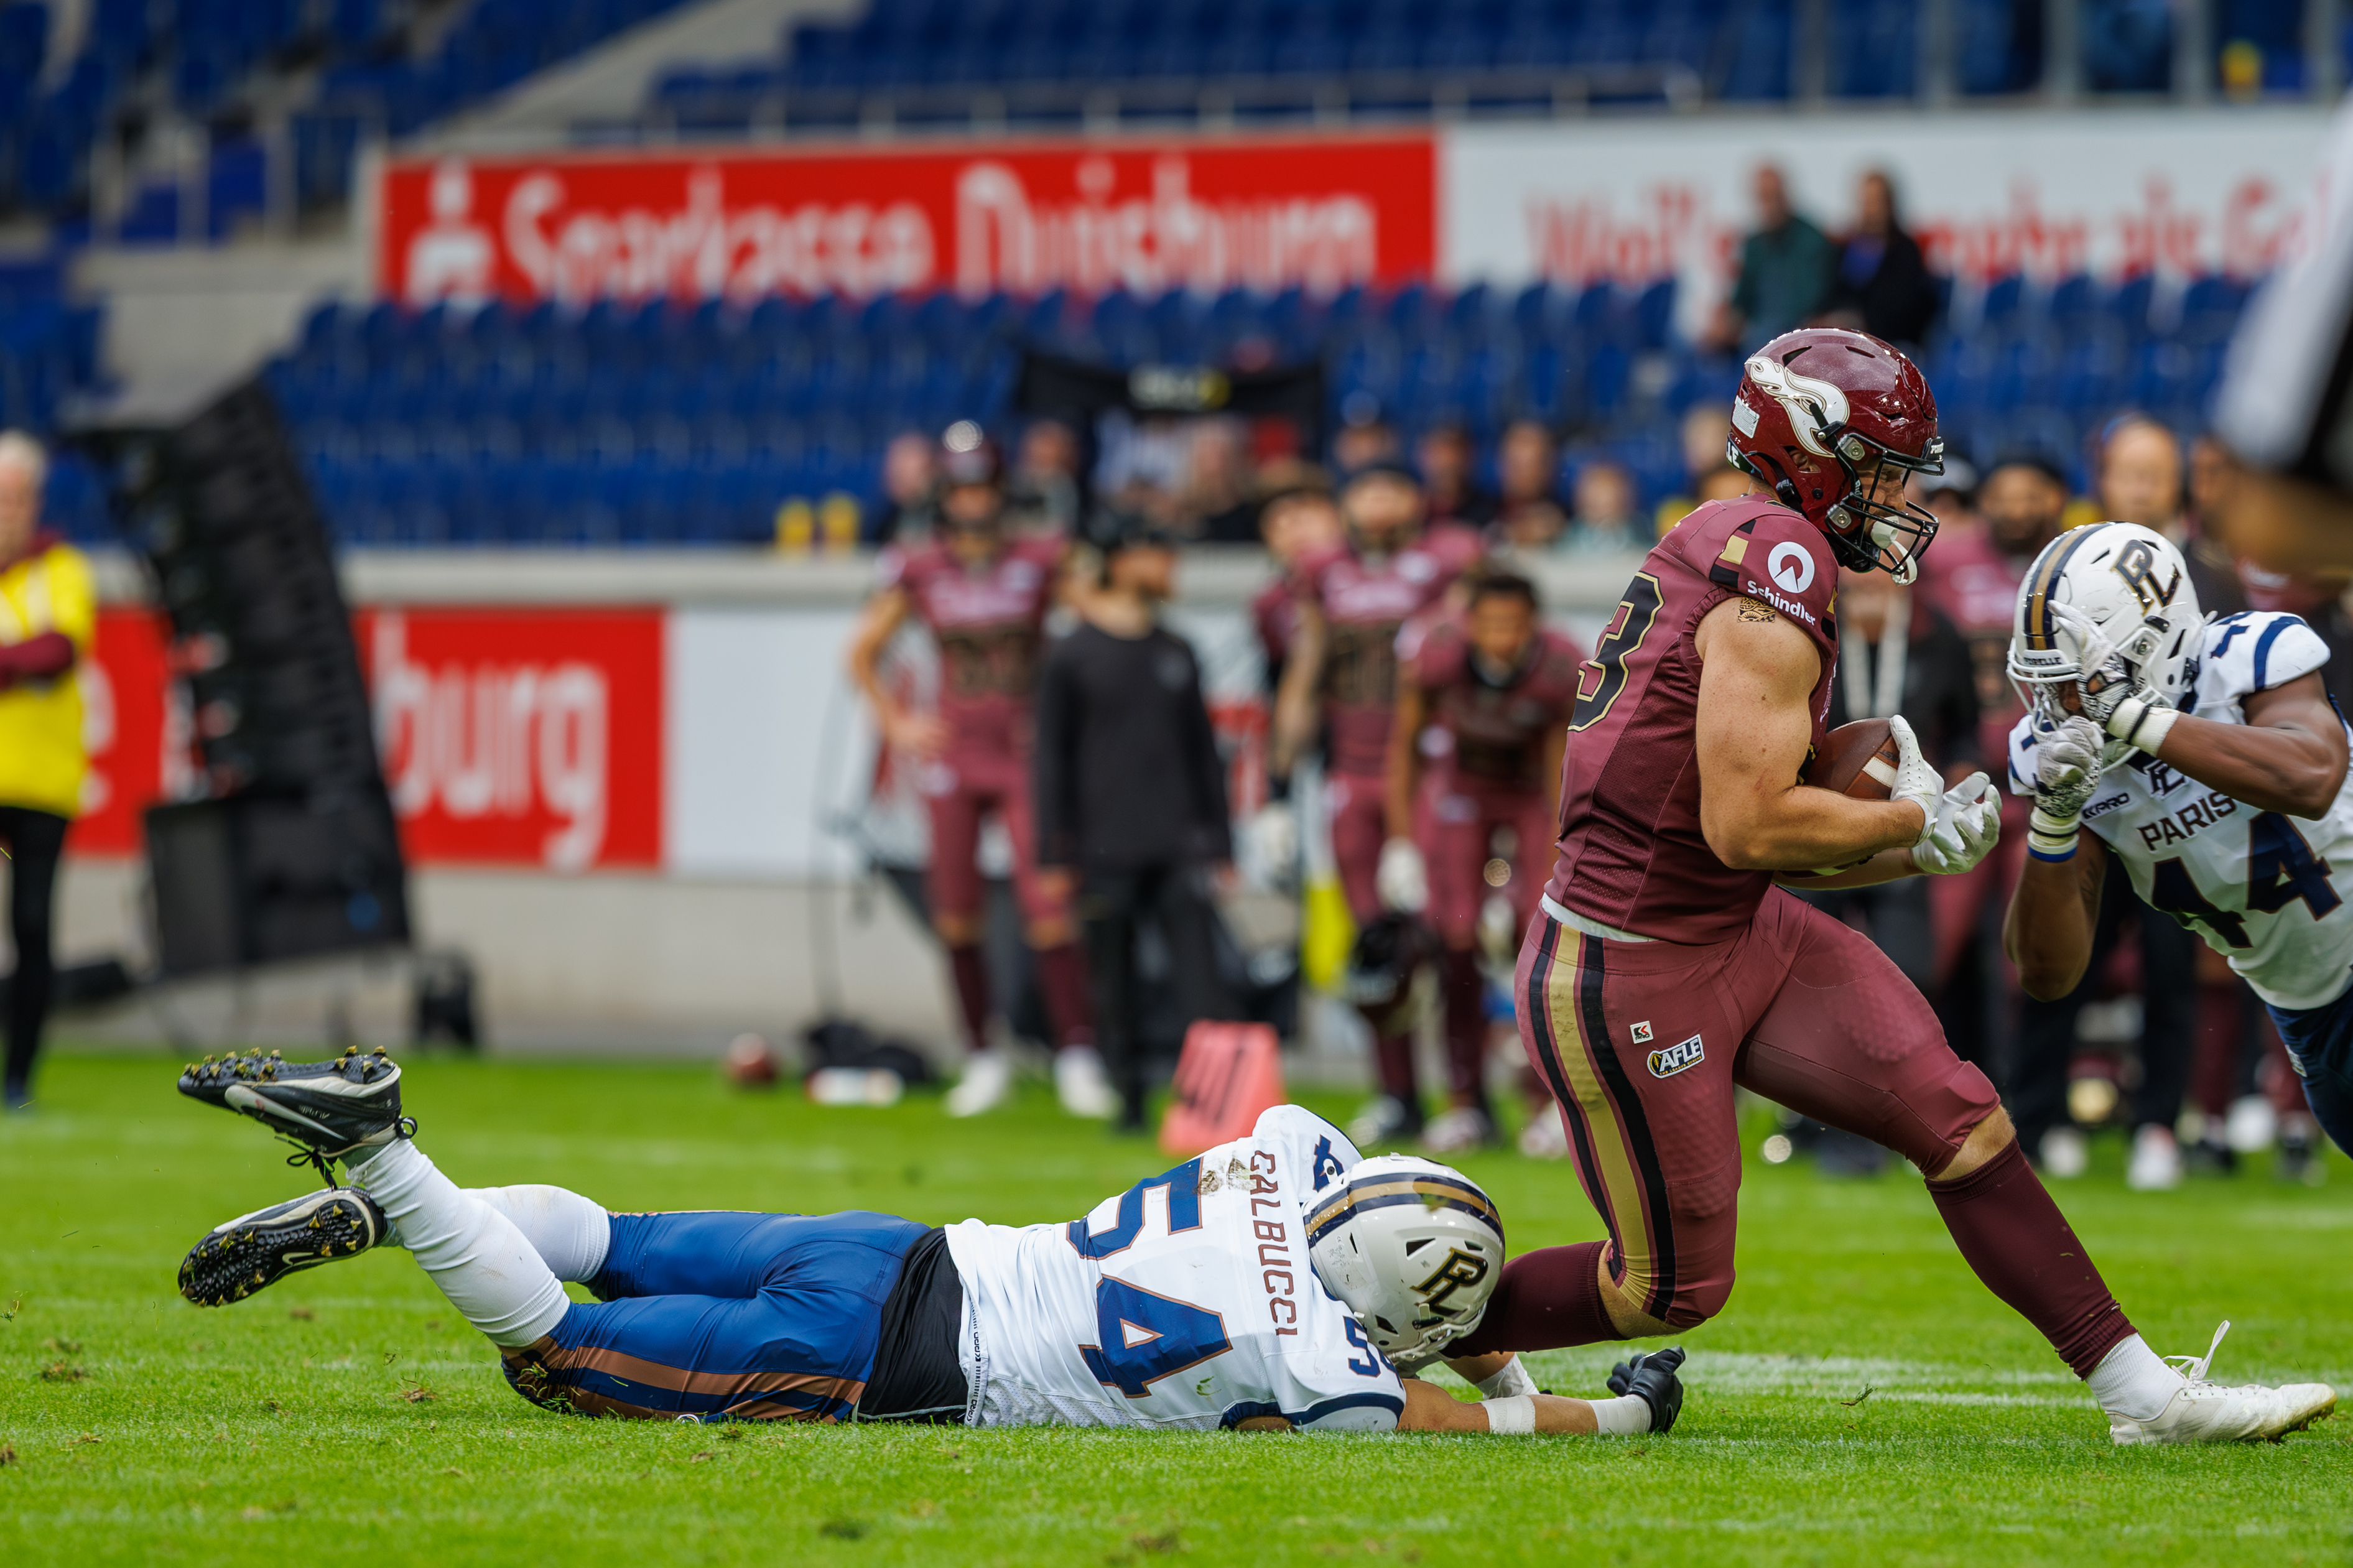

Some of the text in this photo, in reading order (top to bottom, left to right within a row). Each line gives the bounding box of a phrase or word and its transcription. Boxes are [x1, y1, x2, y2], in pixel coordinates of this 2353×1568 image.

[1747, 580, 1816, 626] Schindler
[2137, 791, 2237, 851] PARIS
[1659, 1037, 1701, 1072] AFLE
[1250, 1149, 1298, 1335] GALBUCCI
[1065, 1156, 1233, 1399] 54
